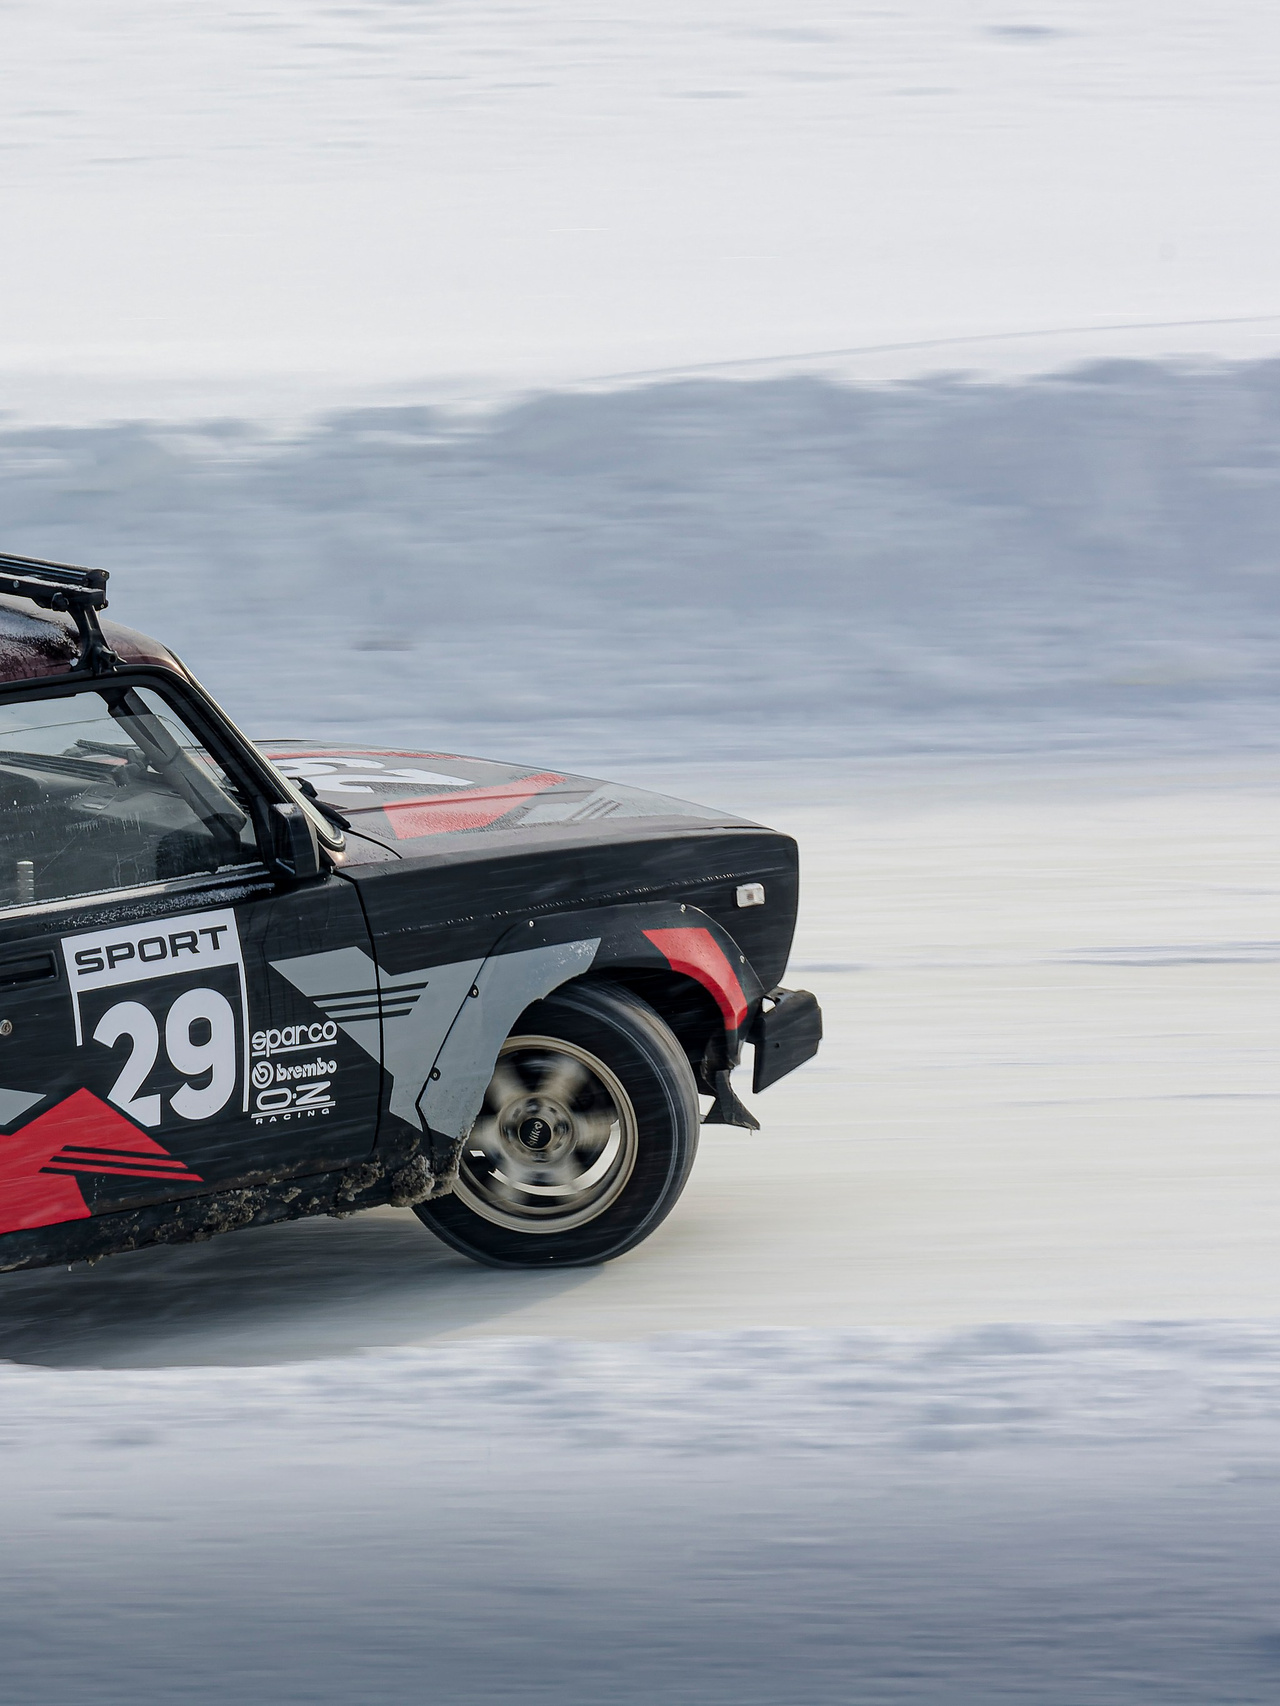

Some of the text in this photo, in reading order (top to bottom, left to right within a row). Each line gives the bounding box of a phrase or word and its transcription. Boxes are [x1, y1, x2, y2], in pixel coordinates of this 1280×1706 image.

[74, 925, 228, 976] SPORT
[252, 1020, 337, 1057] sparco
[92, 987, 236, 1128] 29
[276, 1057, 337, 1082] brembo
[255, 1108, 330, 1125] RACING
